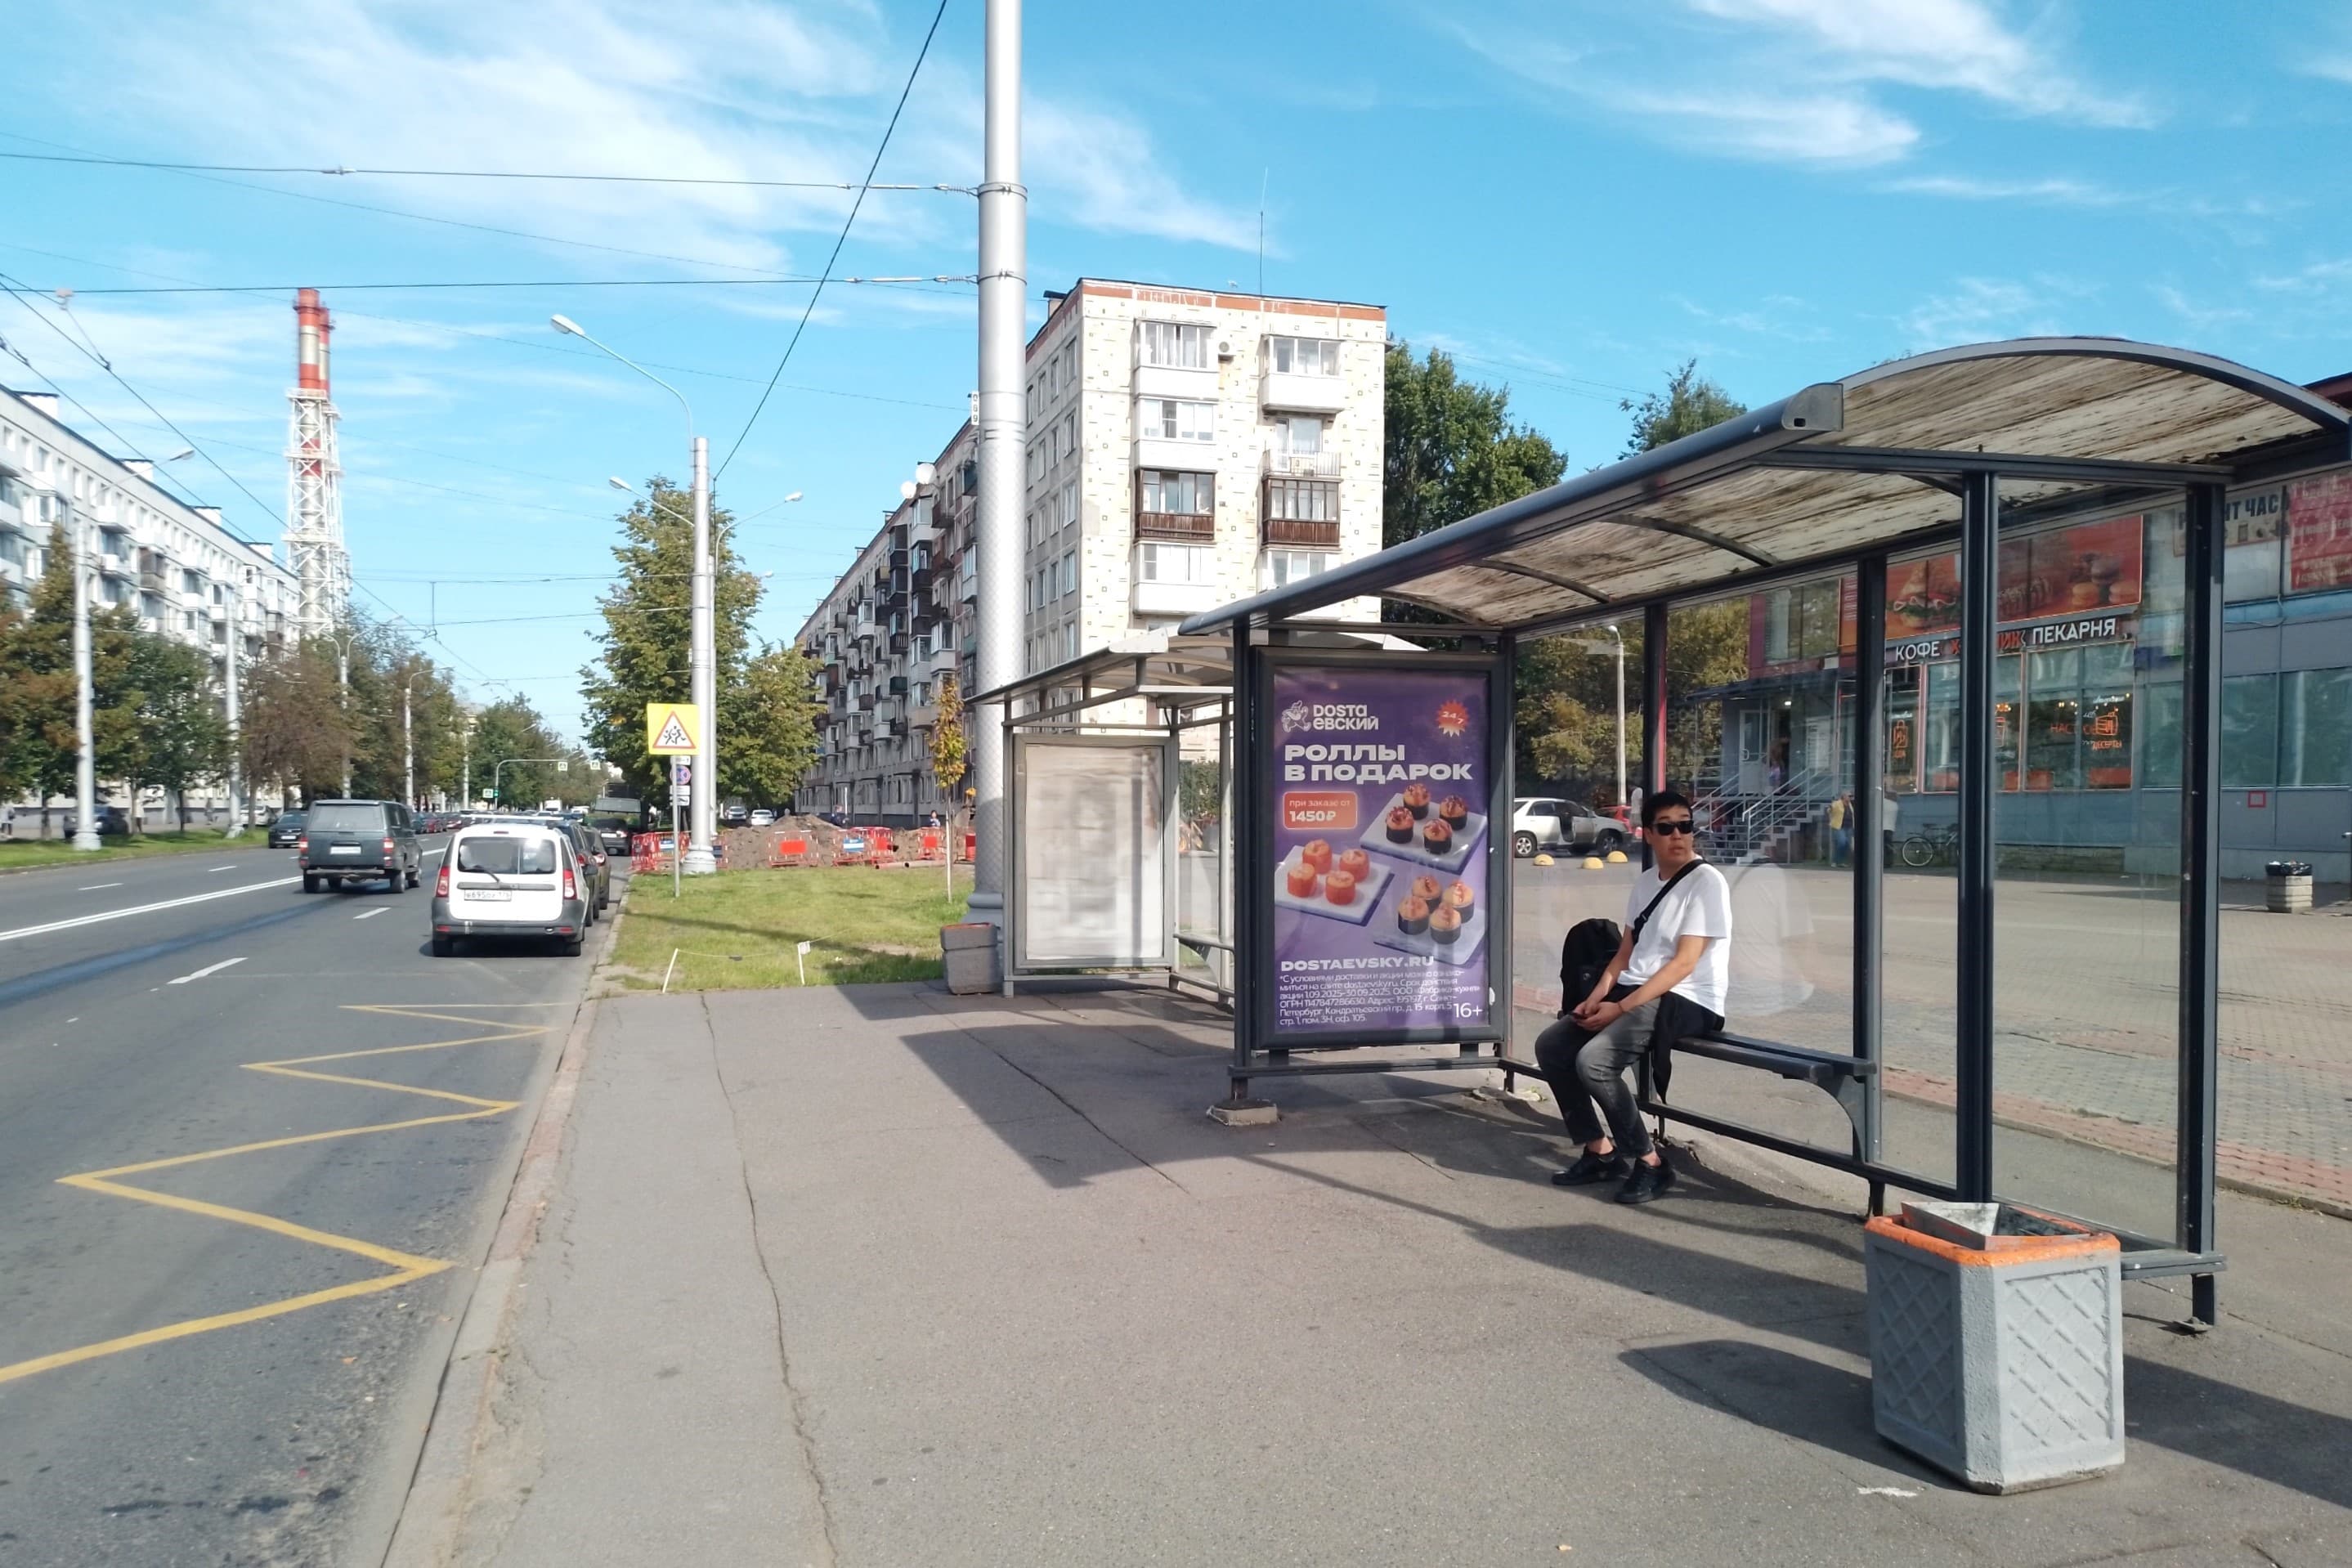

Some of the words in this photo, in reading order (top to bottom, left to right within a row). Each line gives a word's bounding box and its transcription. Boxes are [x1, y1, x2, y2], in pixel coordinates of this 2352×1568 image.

[2032, 618, 2116, 645] ПЕКАРНЯ
[1896, 641, 1940, 661] КОФЕ
[1441, 711, 1464, 724] 24/7
[1284, 744, 1405, 761] РОЛЛЫ
[1284, 764, 1306, 781] В
[1311, 764, 1472, 785] ПОДАРОК
[1289, 800, 1306, 809] при
[1289, 810, 1336, 822] 1450₽
[1281, 956, 1434, 971] DOSTAEVSKY.RU
[1290, 974, 1333, 984] условиями
[1335, 973, 1372, 982] доставки
[1279, 983, 1308, 992] миться
[1400, 979, 1420, 988] Срок
[1392, 987, 1413, 995] ООО
[1279, 999, 1303, 1008] ОГРН
[1453, 1002, 1483, 1019] 16+
